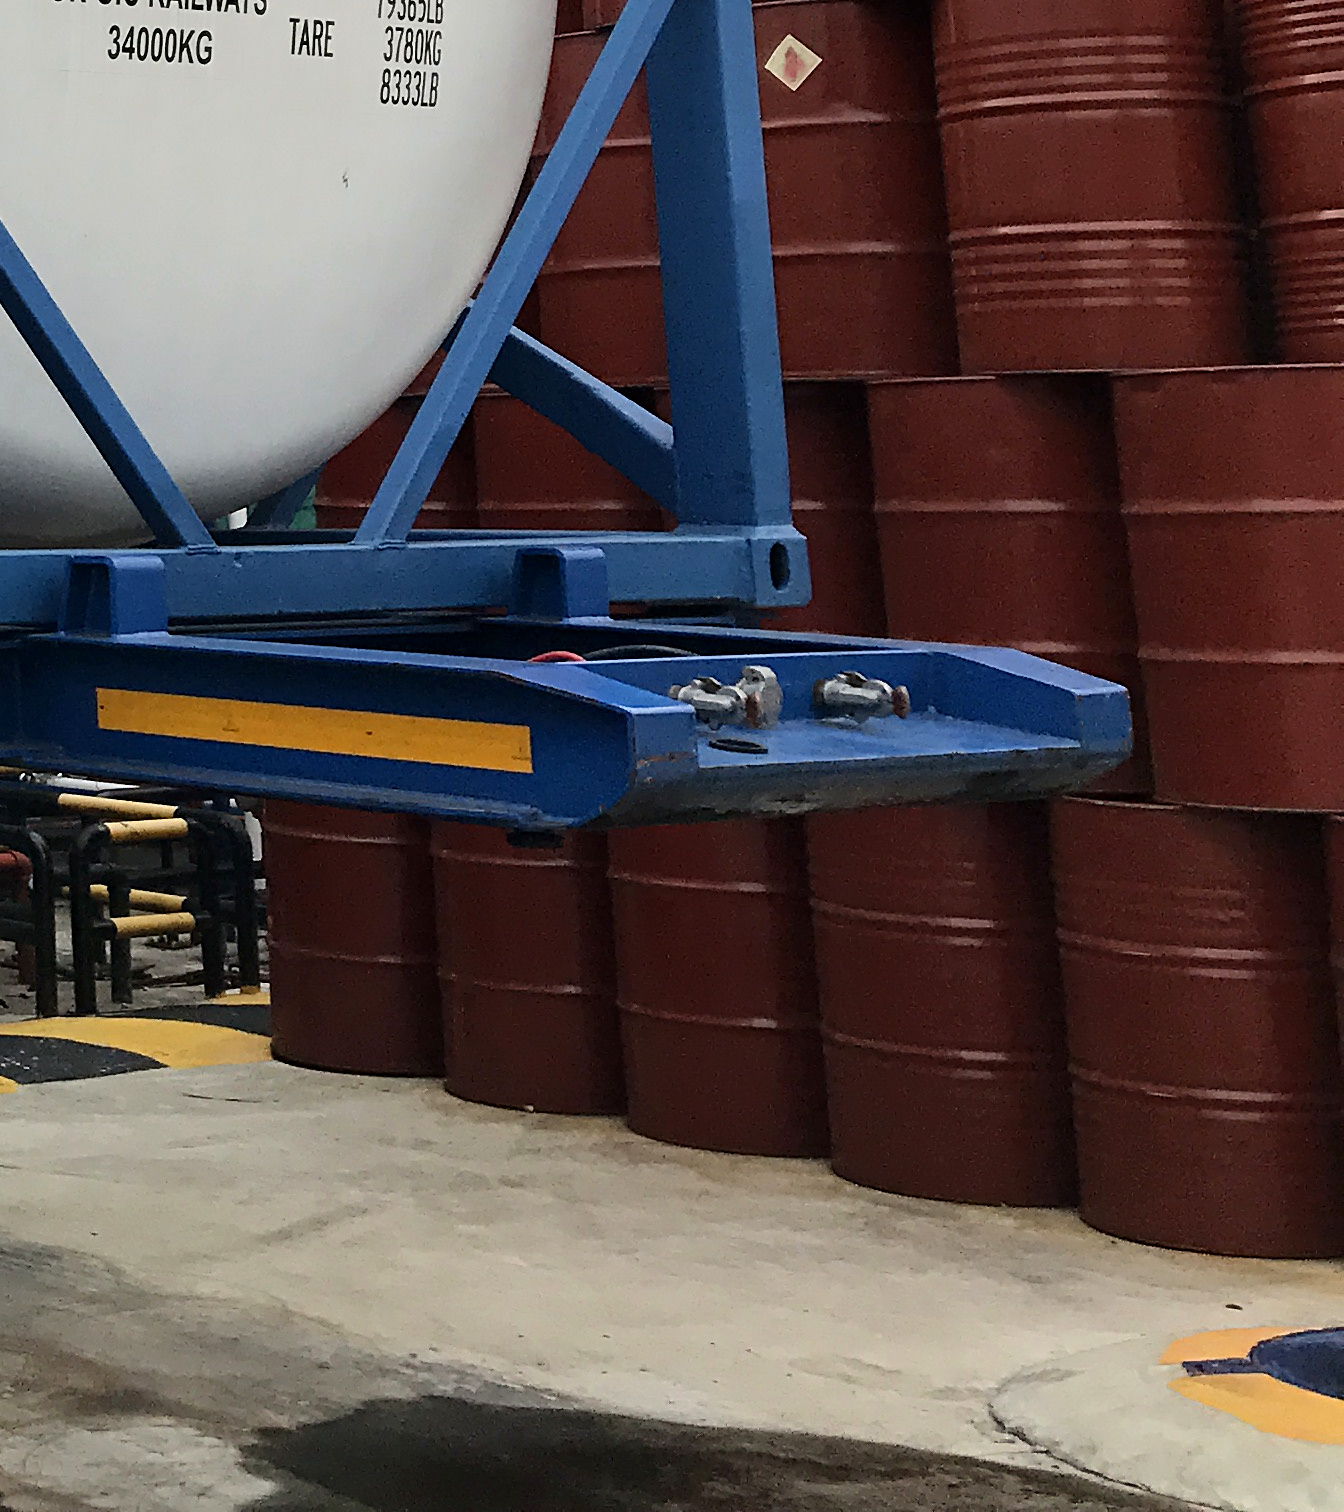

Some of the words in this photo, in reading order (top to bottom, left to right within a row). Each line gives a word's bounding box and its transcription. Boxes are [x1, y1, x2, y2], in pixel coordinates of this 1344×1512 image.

[107, 24, 214, 66] 34000KG
[289, 17, 336, 58] TARE
[382, 25, 443, 67] 3780KG
[380, 68, 440, 108] 8333LB
